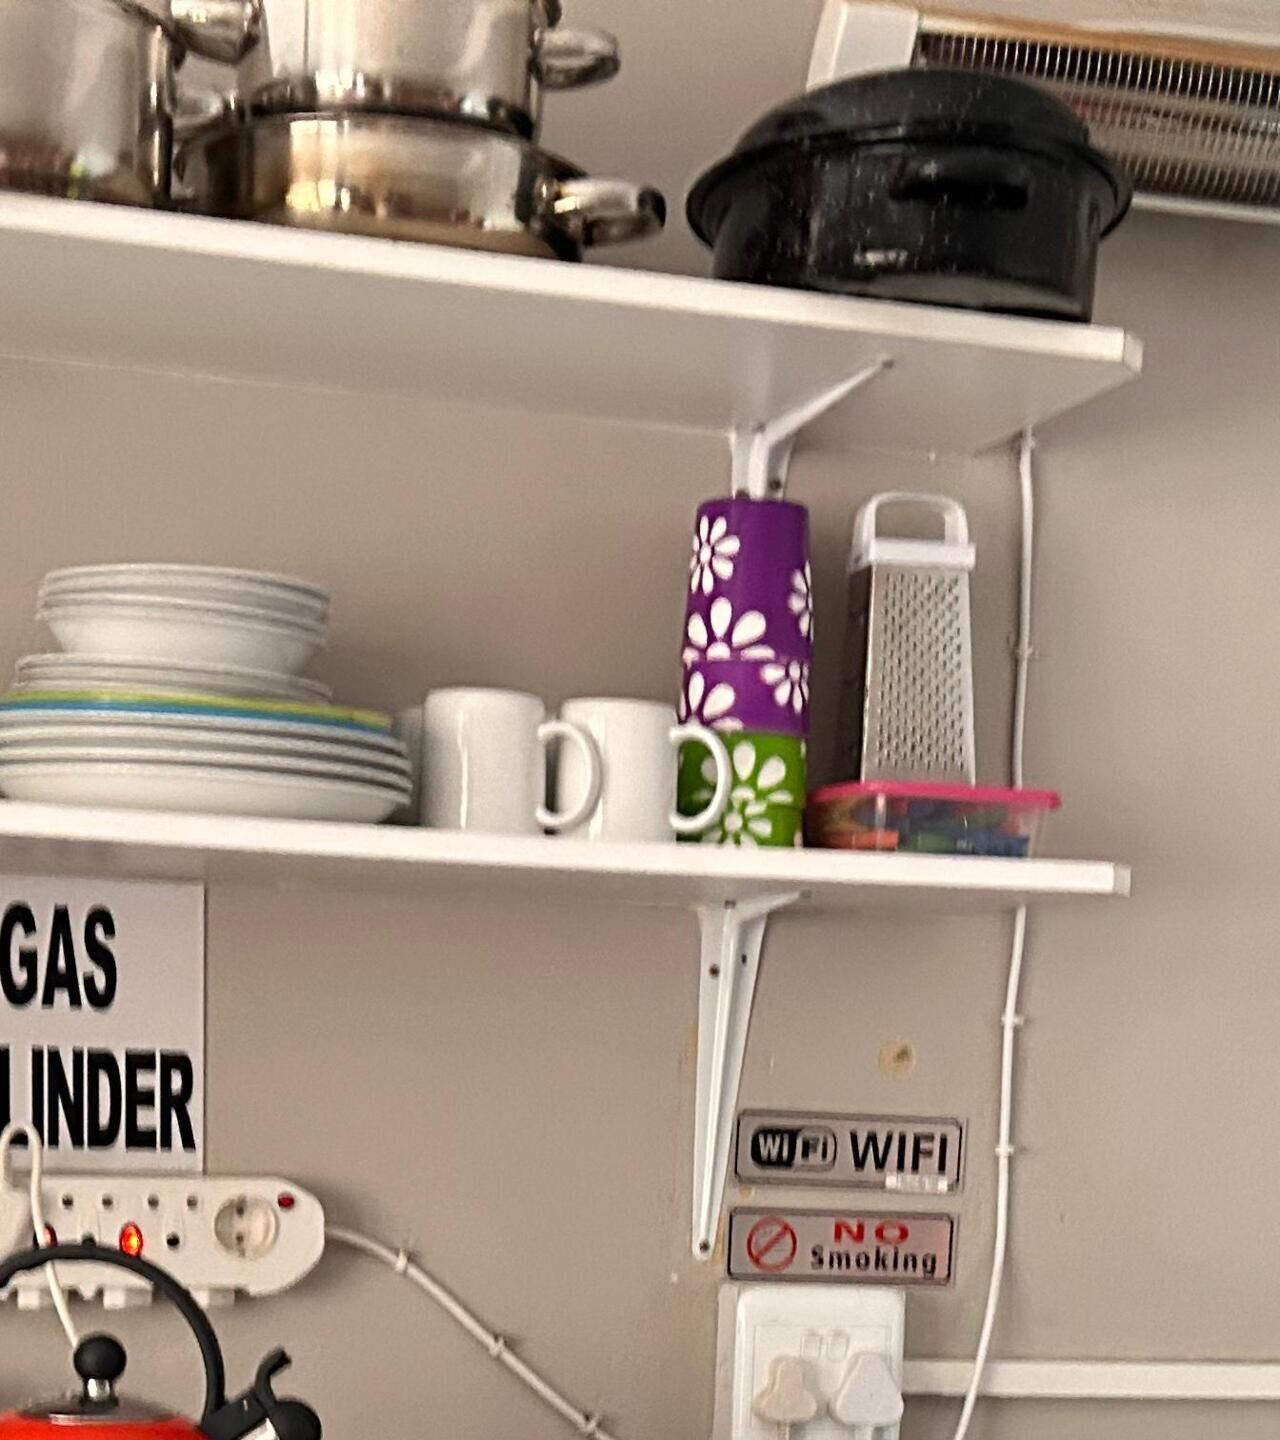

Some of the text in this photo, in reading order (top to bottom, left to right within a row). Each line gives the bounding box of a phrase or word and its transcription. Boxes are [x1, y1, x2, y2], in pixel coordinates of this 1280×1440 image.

[850, 1130, 948, 1174] WIFI
[833, 1219, 910, 1245] NO
[810, 1244, 937, 1280] Smoking
